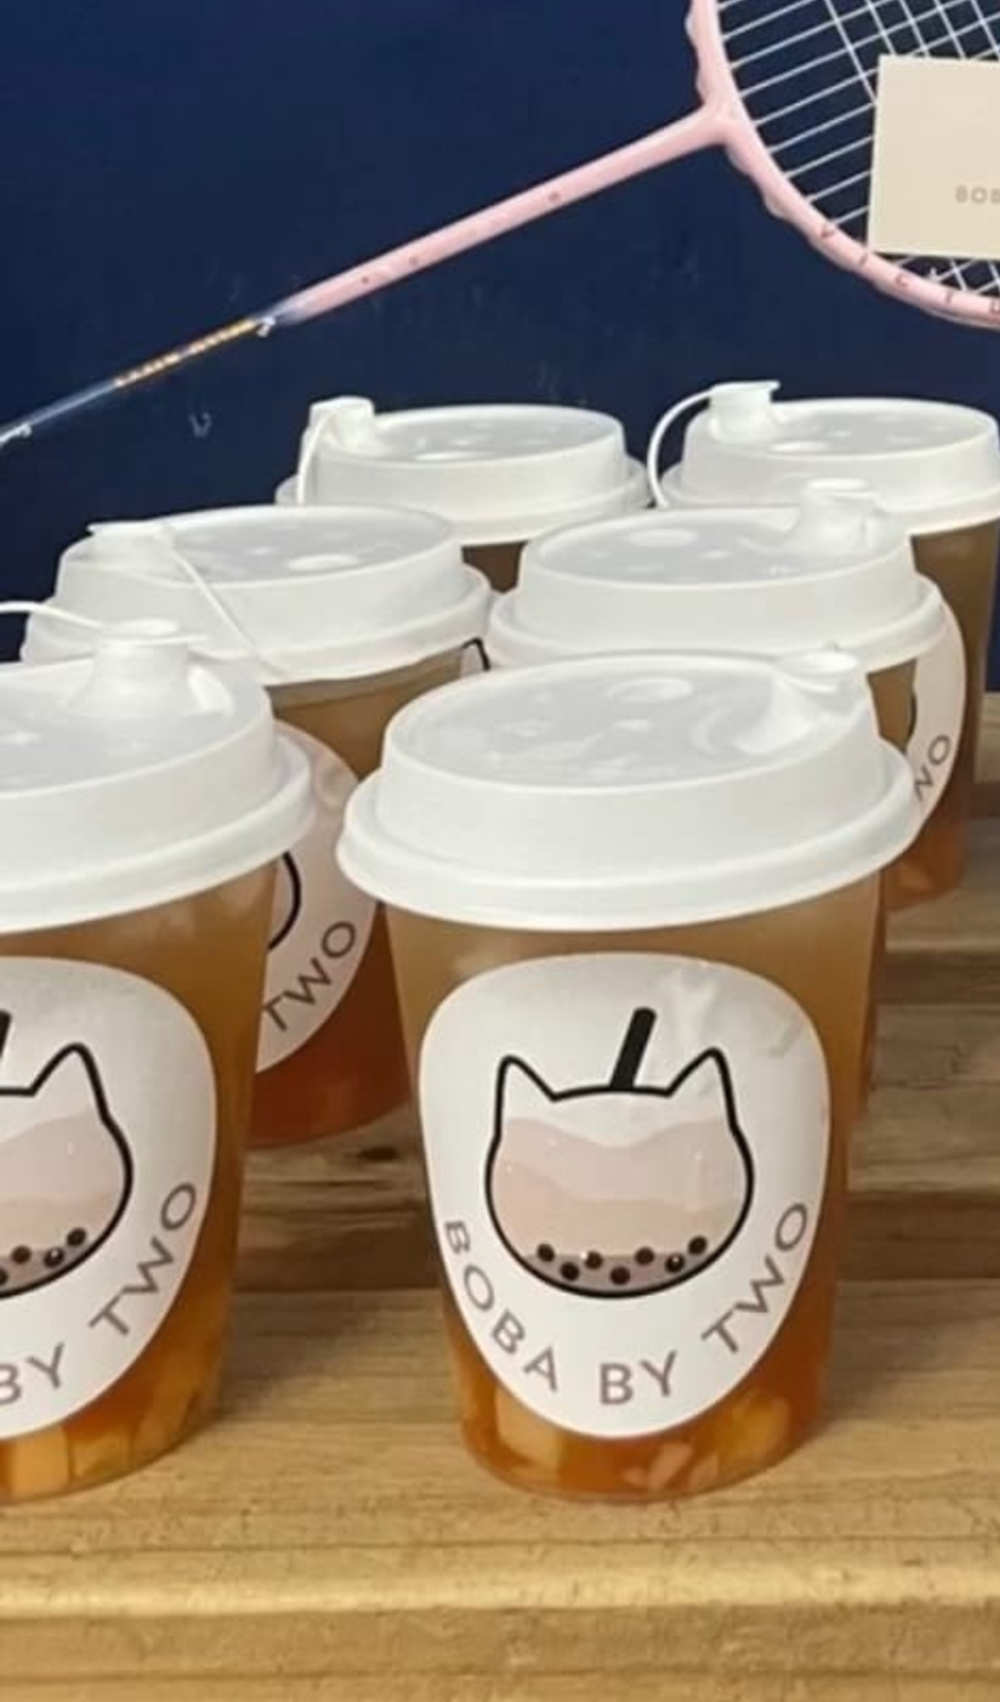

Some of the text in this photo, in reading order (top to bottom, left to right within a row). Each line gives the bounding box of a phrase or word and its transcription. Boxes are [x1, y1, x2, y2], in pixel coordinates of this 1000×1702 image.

[87, 1182, 197, 1336] TWO
[445, 1202, 808, 1405] BOBA BY TWO
